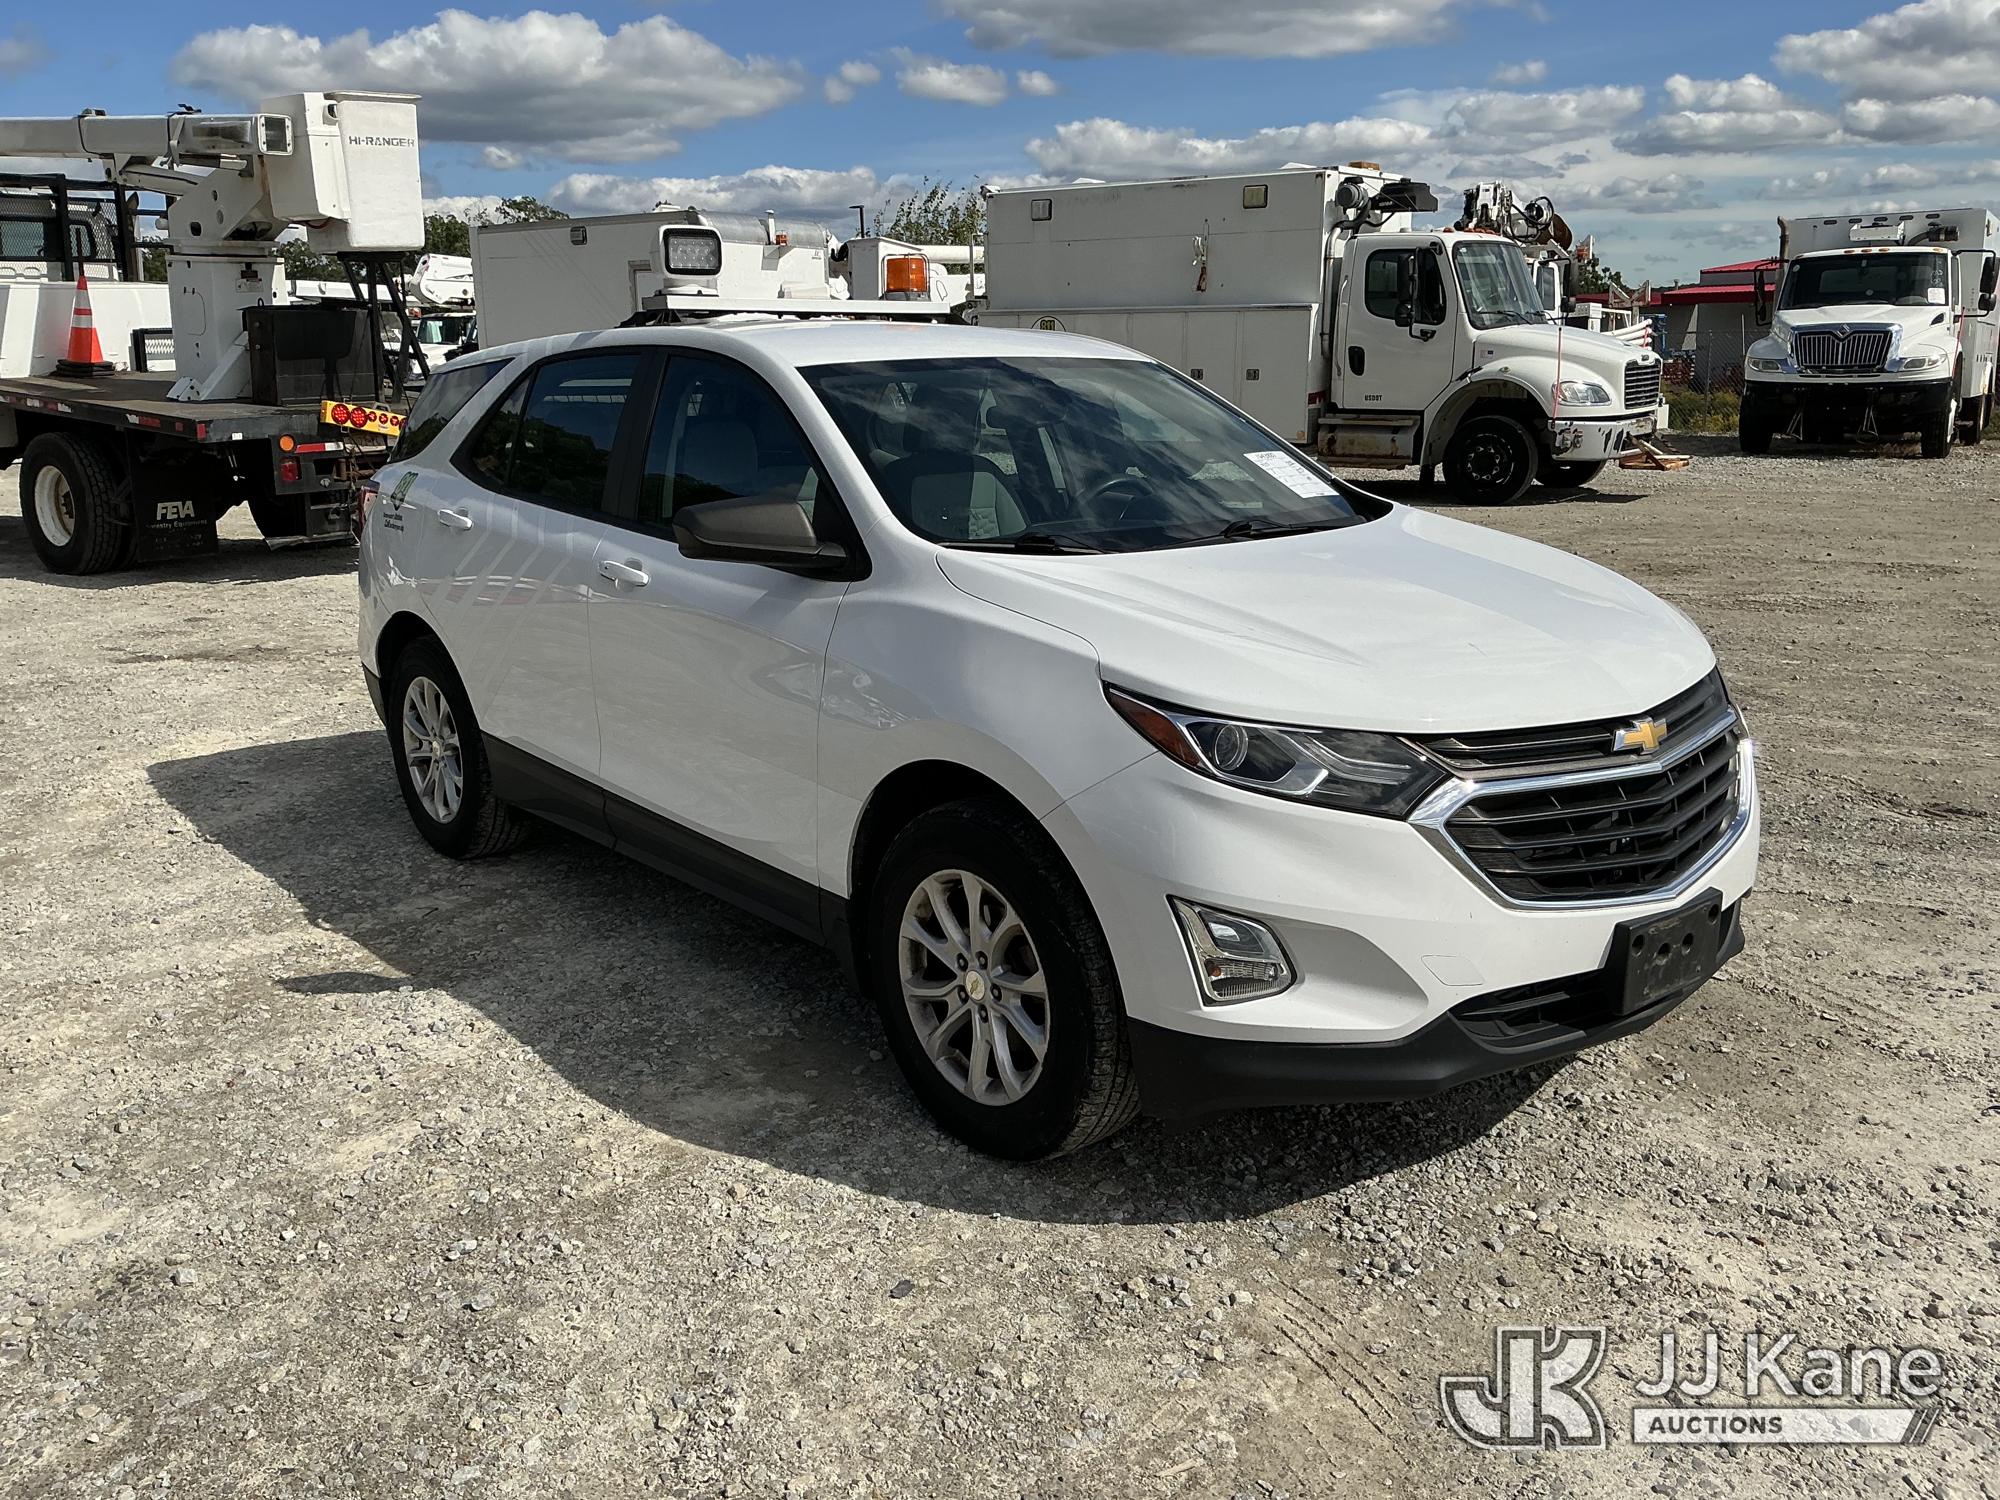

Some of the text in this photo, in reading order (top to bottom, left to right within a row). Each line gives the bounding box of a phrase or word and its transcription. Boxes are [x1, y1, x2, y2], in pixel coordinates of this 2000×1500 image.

[348, 135, 415, 148] HI-RANGER
[1040, 319, 1056, 331] 811
[156, 500, 195, 521] FEVA
